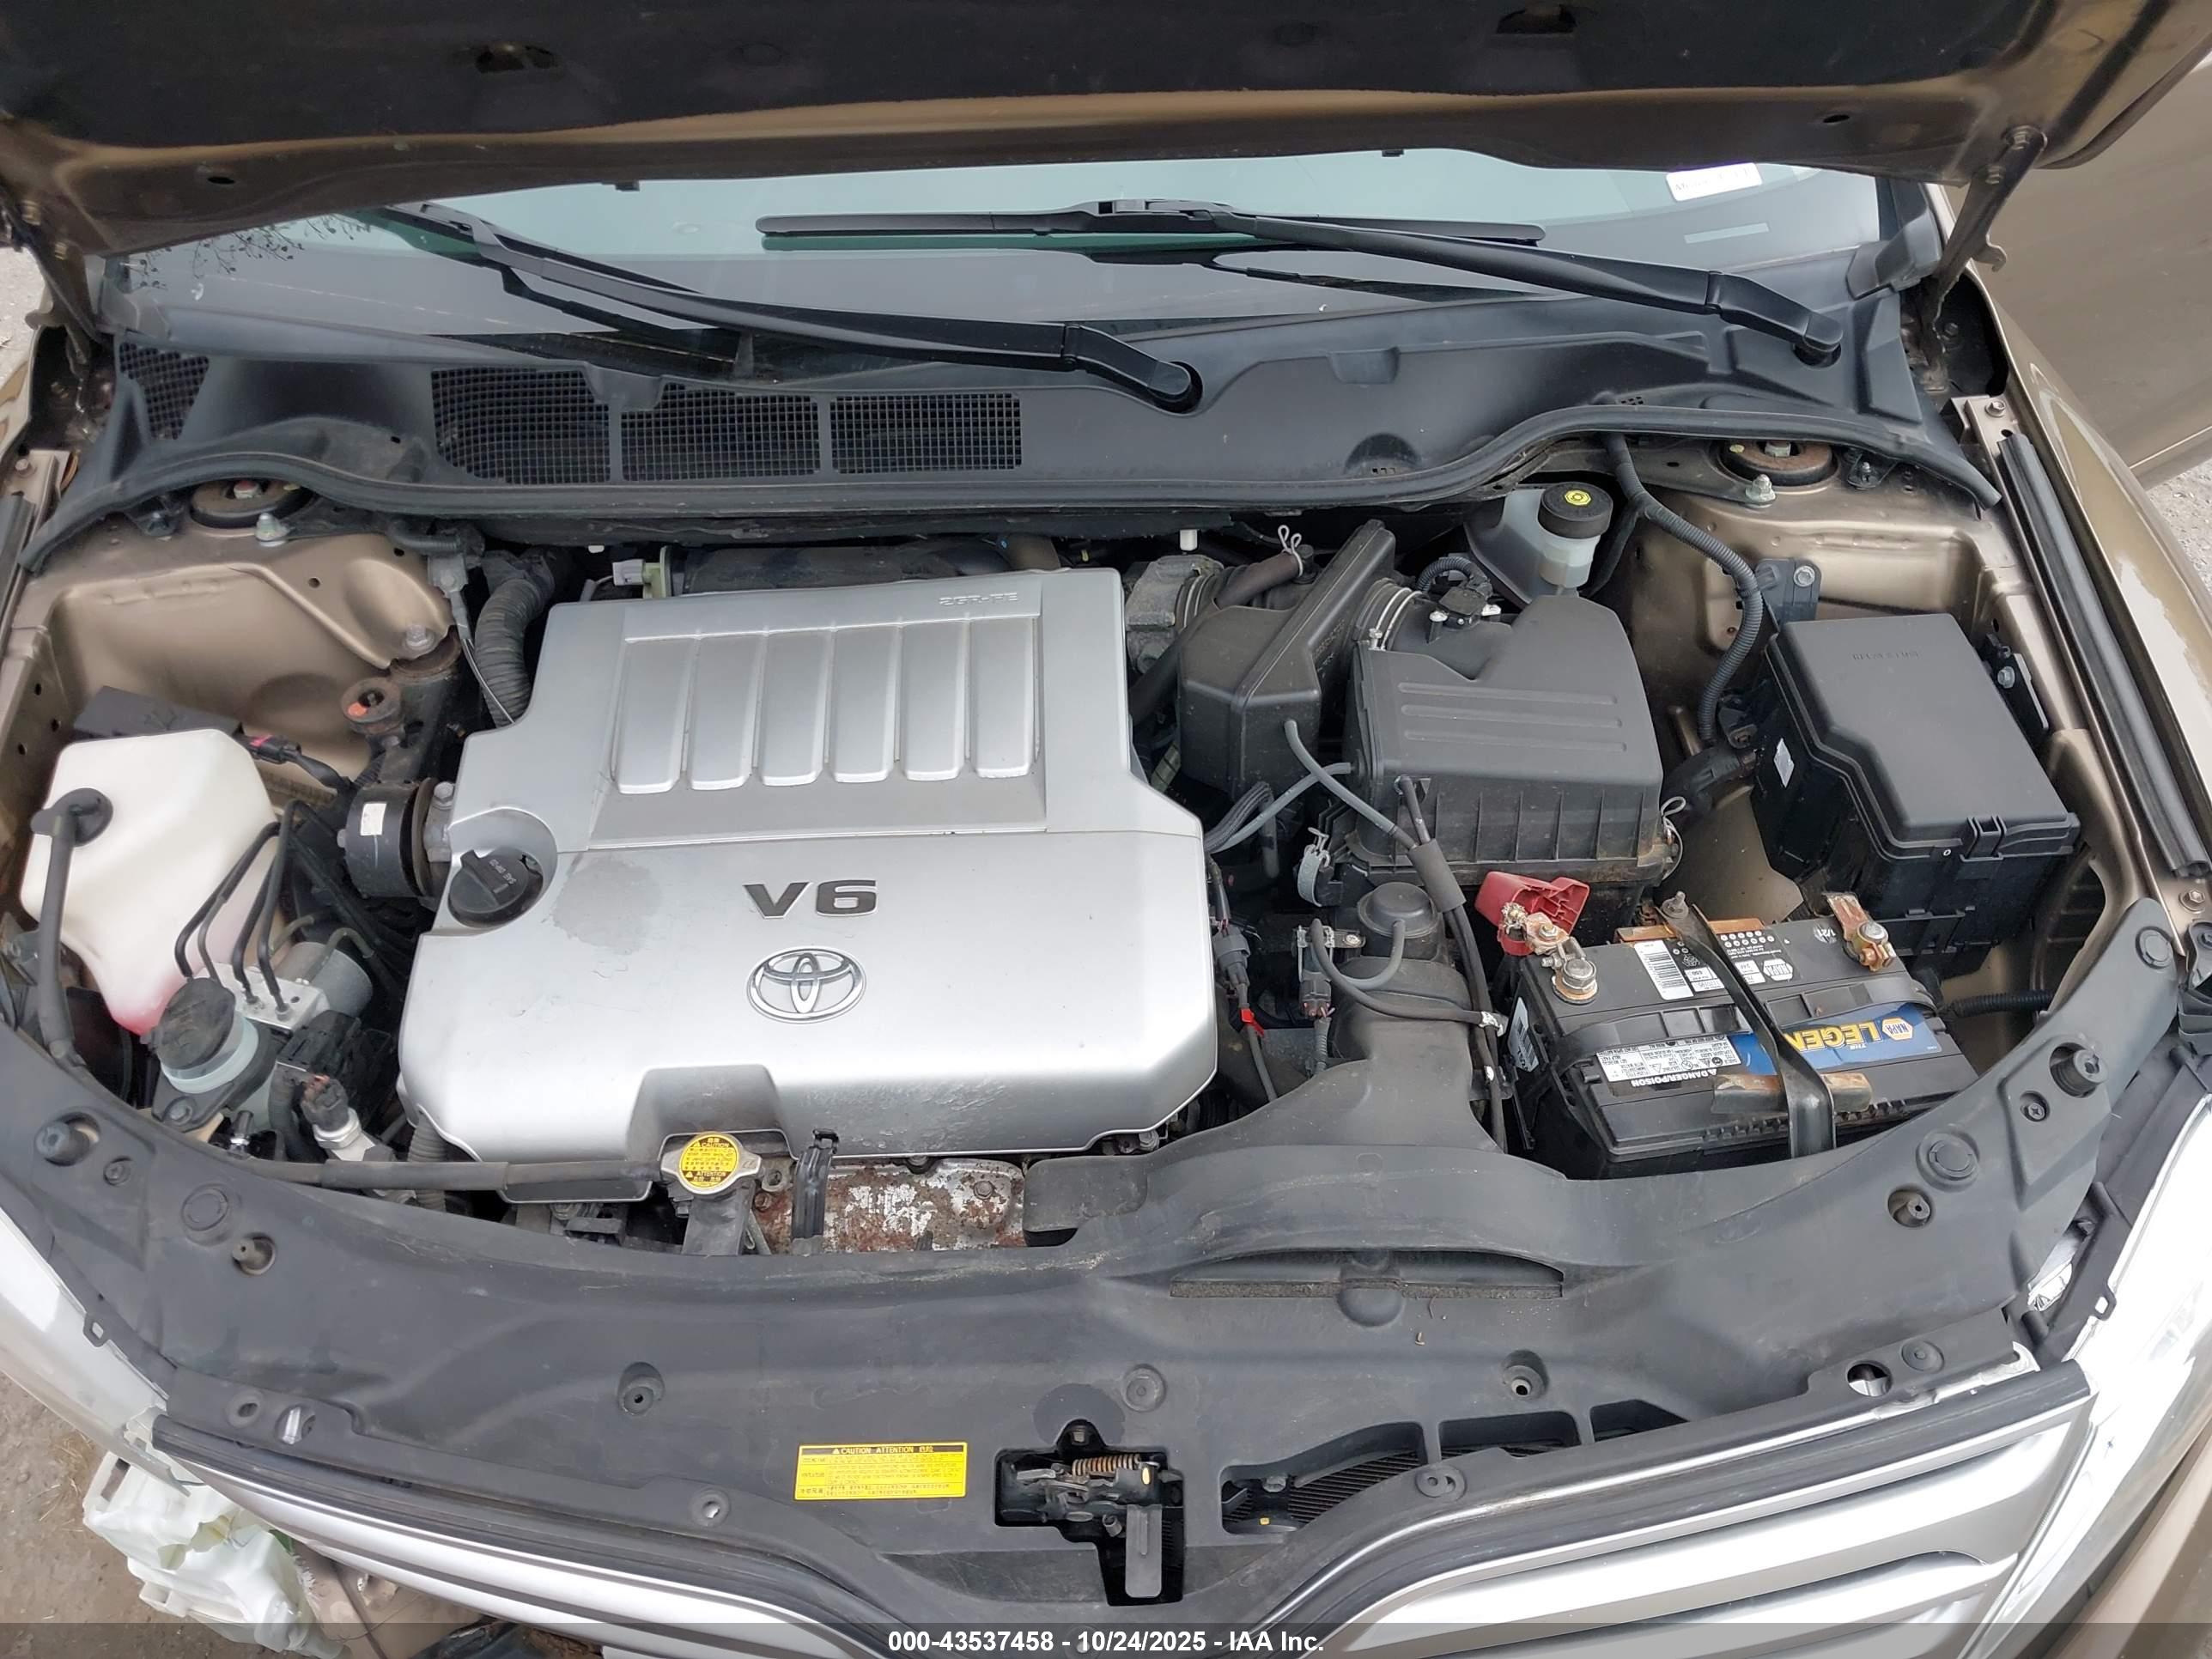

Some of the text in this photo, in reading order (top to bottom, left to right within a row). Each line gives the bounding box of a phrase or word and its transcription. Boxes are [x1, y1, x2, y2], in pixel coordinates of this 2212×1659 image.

[743, 878, 878, 919] V6
[1783, 1020, 1882, 1053] LEGEN
[1884, 1023, 1909, 1035] NAPA
